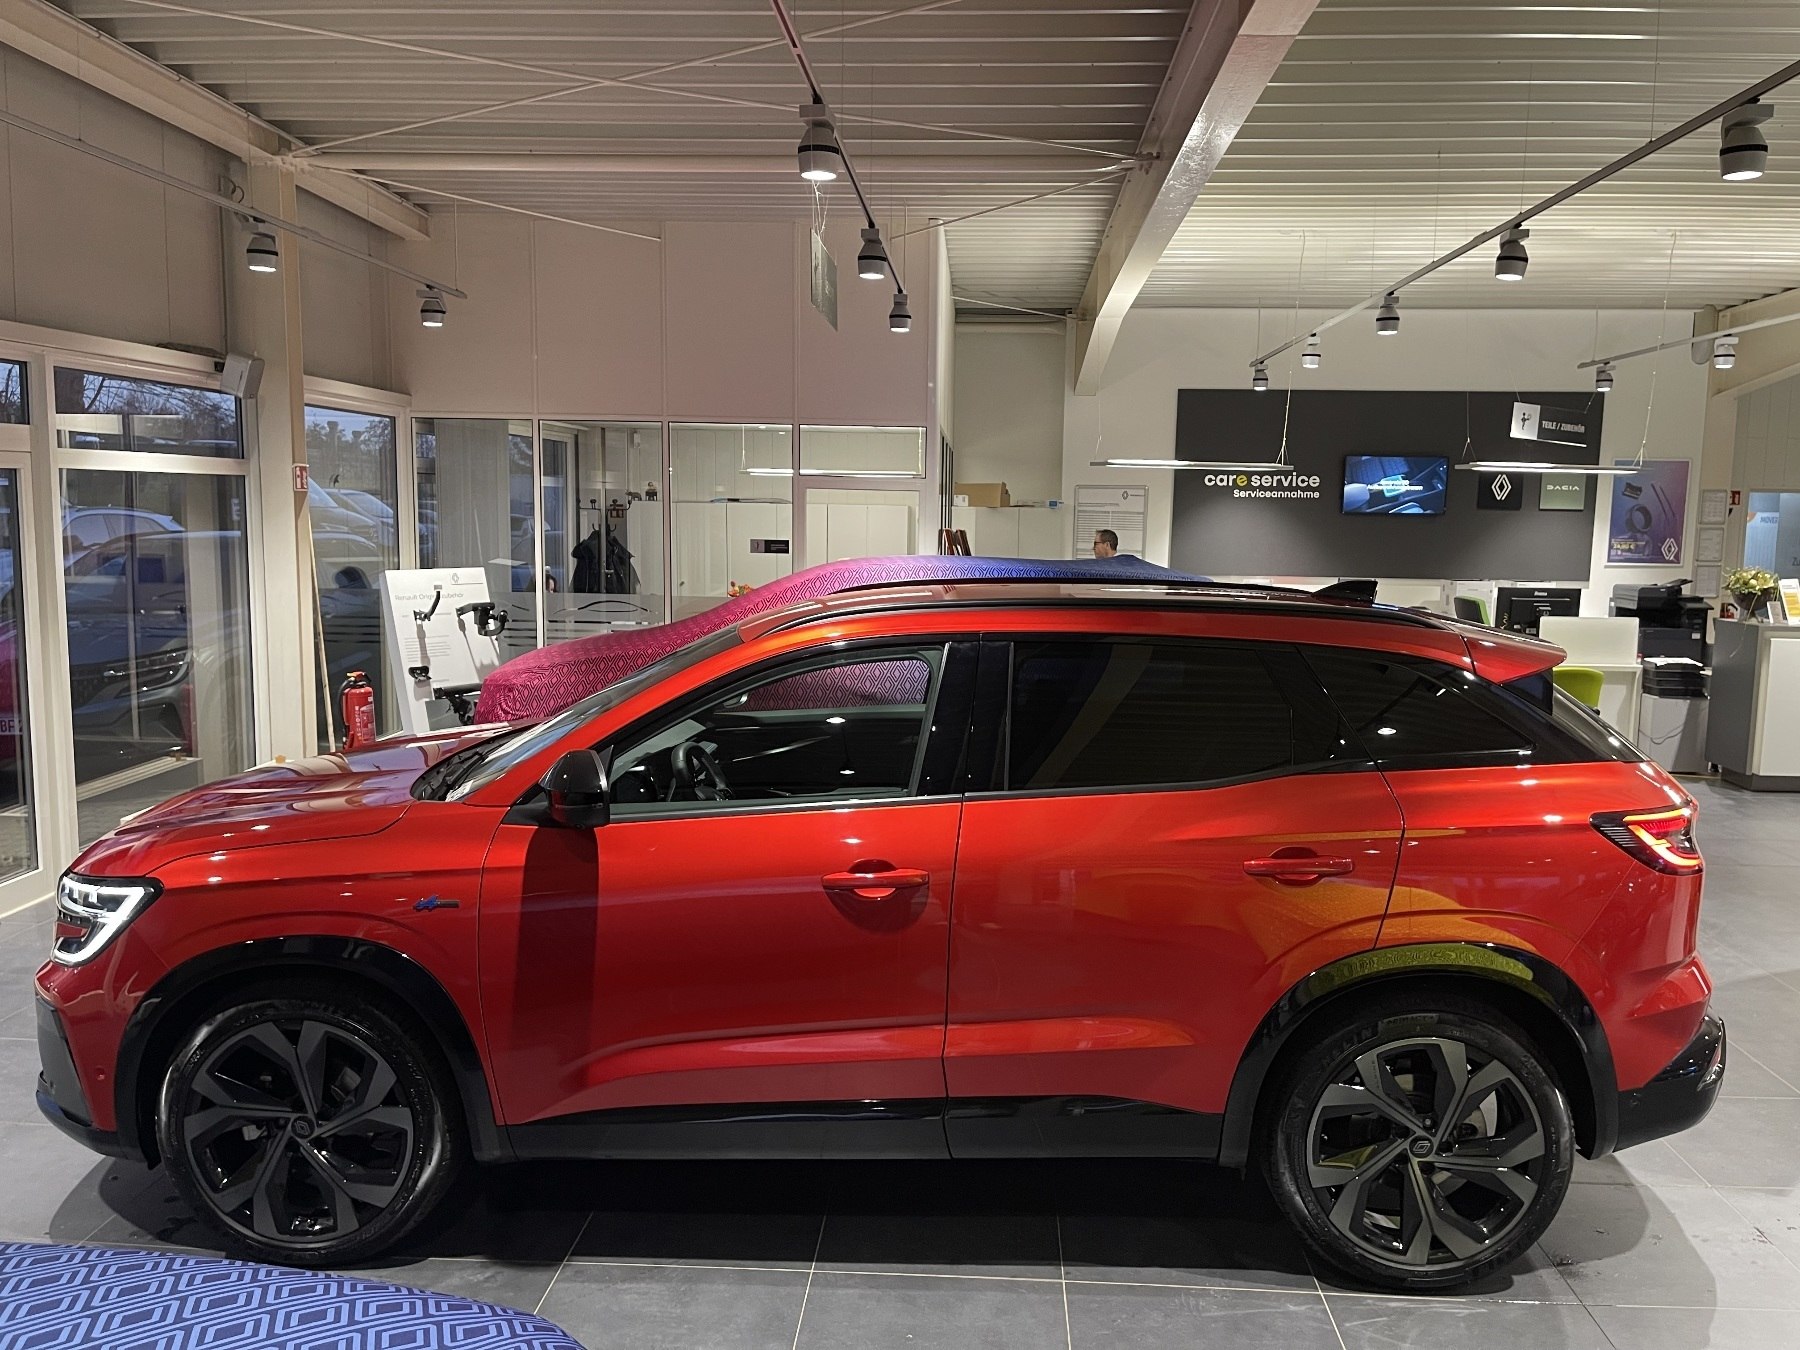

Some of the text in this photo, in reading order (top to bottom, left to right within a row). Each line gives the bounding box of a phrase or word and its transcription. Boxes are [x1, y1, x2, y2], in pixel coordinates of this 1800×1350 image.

[1542, 420, 1557, 430] TEILE
[1204, 472, 1320, 487] care service
[1233, 488, 1320, 499] Serviceannahme
